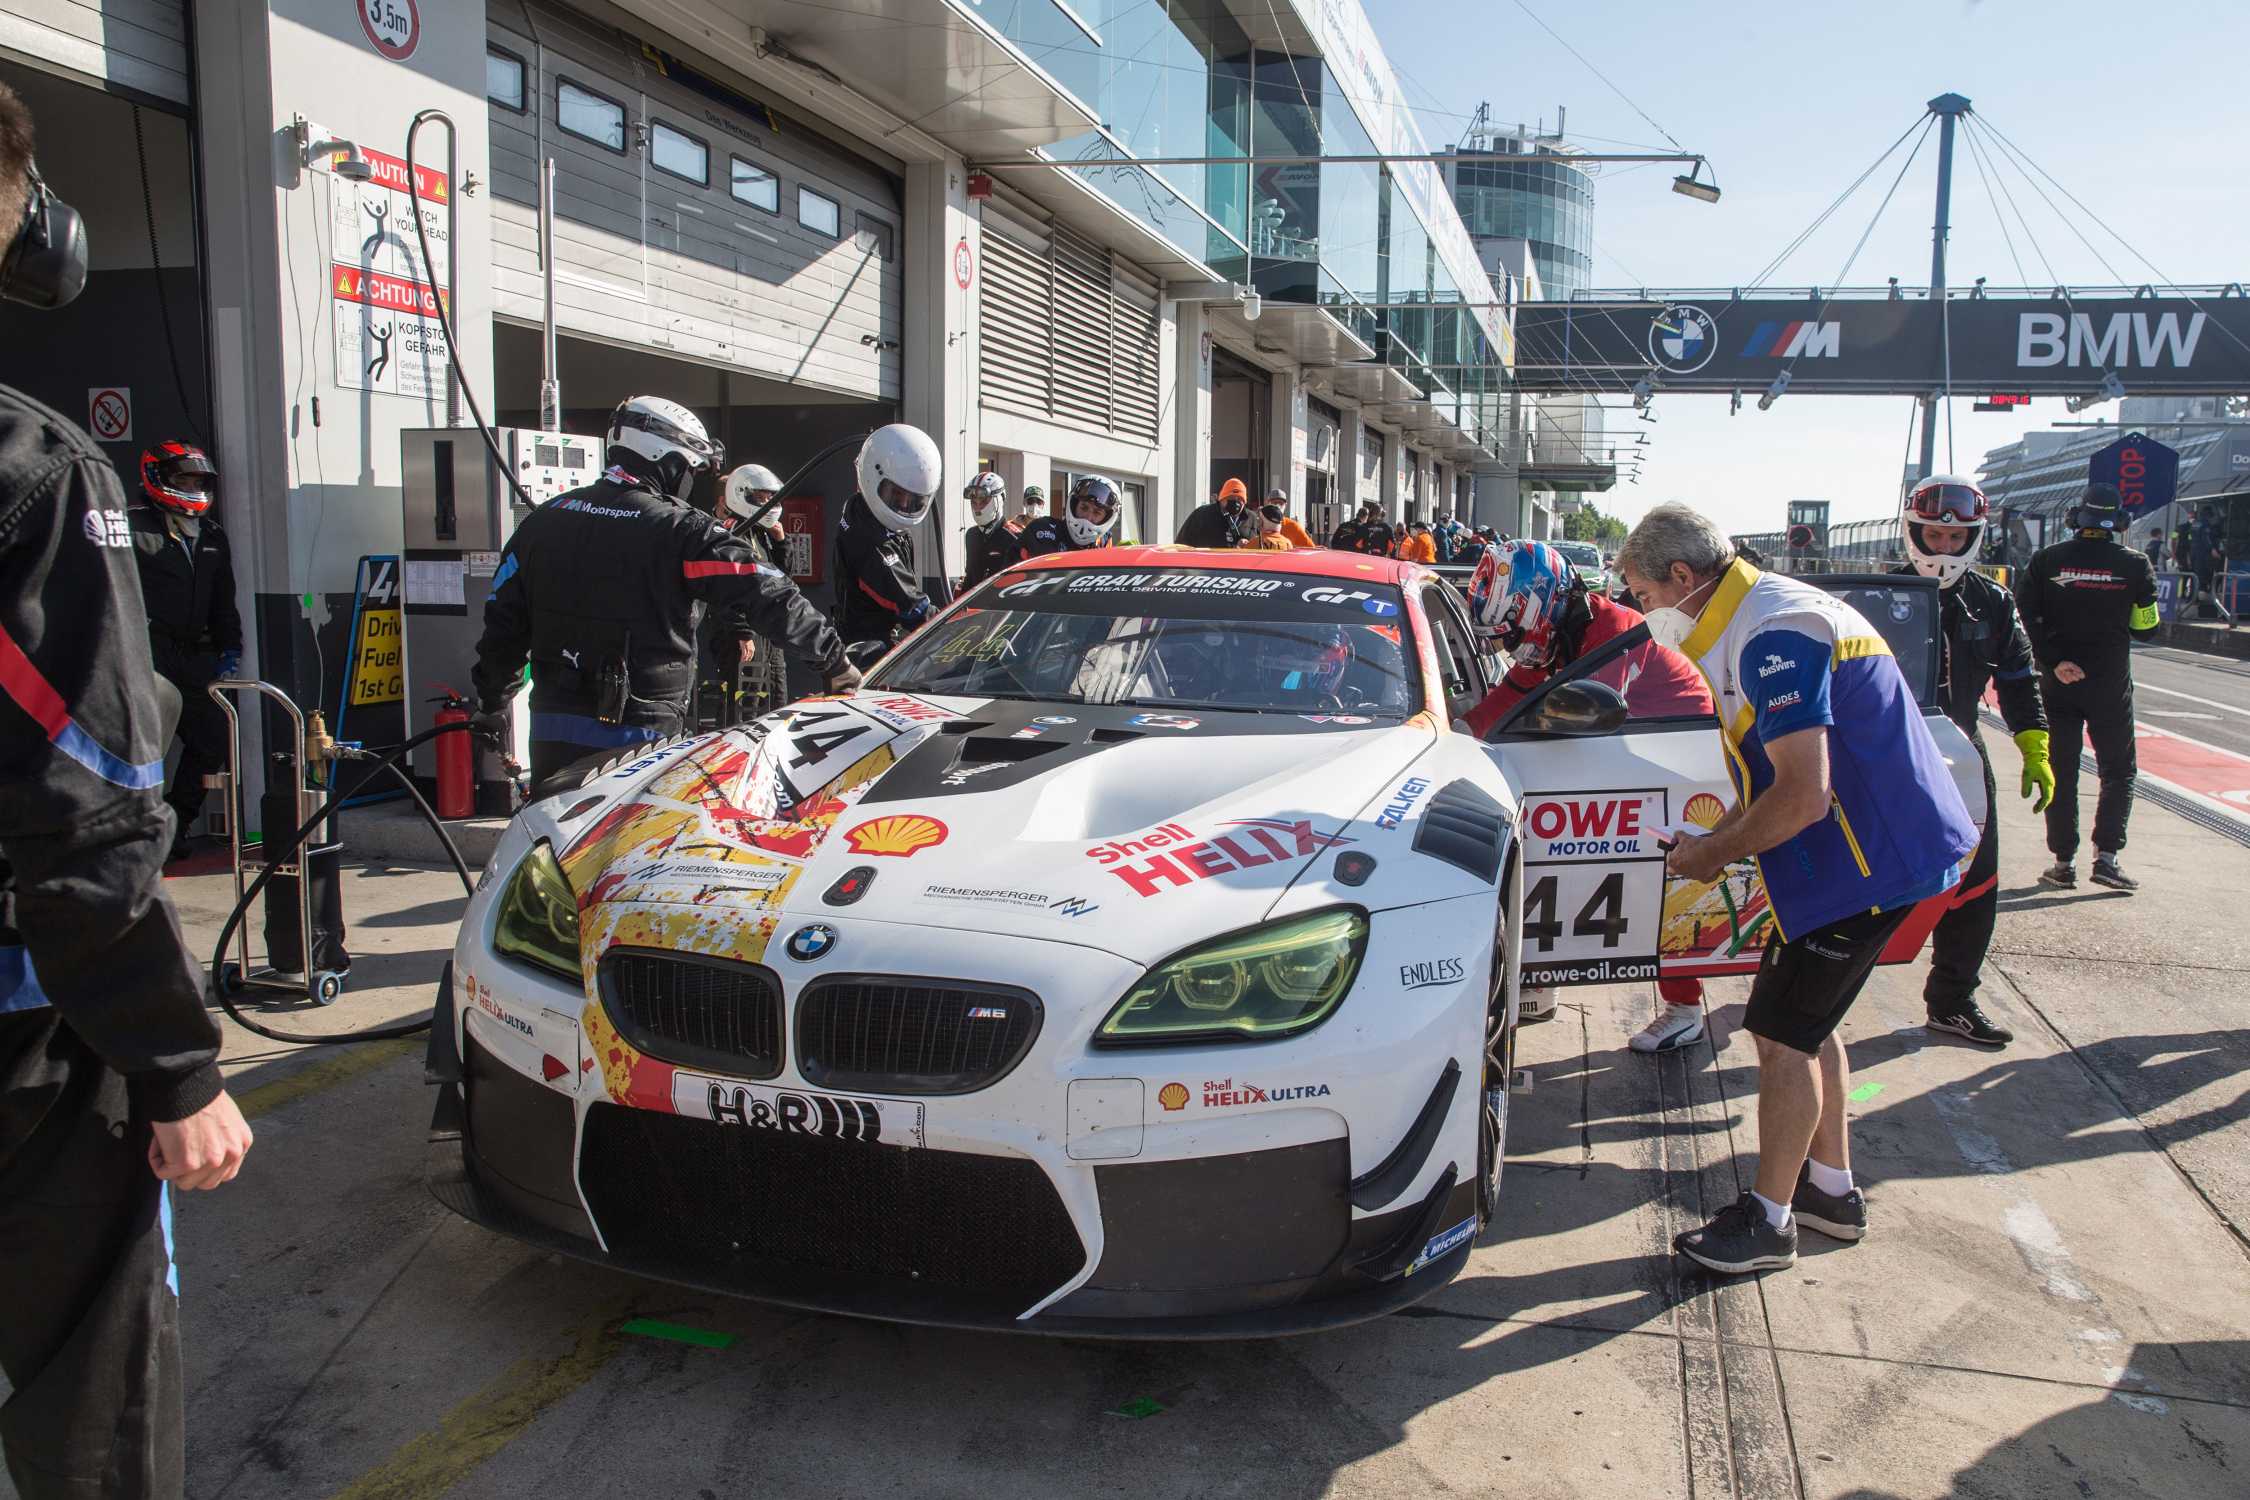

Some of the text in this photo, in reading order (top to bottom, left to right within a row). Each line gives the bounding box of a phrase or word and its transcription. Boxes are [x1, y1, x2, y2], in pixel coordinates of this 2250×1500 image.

[405, 206, 438, 224] WTCH
[355, 276, 436, 311] ACHTUNG
[399, 321, 446, 341] KOPFSTO
[2017, 312, 2208, 368] BMW
[405, 340, 446, 357] GEFAHR
[2120, 447, 2145, 508] STOP
[582, 502, 640, 518] Moorsport
[367, 561, 400, 604] 4
[1069, 574, 1153, 588] GRAN
[1190, 588, 1271, 598] SIMULATOR
[360, 679, 384, 699] 1st
[1768, 690, 1800, 708] AUDES
[1374, 776, 1432, 830] FALKEN
[1086, 823, 1196, 864] Shell
[1548, 840, 1641, 856] MOTOR OIL
[1107, 819, 1352, 897] HELIX
[674, 865, 785, 881] RIEMENSPERGER
[926, 885, 1049, 904] RIEMENSPERGER
[1523, 872, 1629, 953] 44
[1400, 957, 1464, 986] ENDLESS
[503, 1012, 534, 1037] ULTRA
[1203, 1079, 1232, 1092] Shell
[1203, 1084, 1331, 1107] HELIX ULTRA
[1430, 1223, 1476, 1257] MICHELIN
